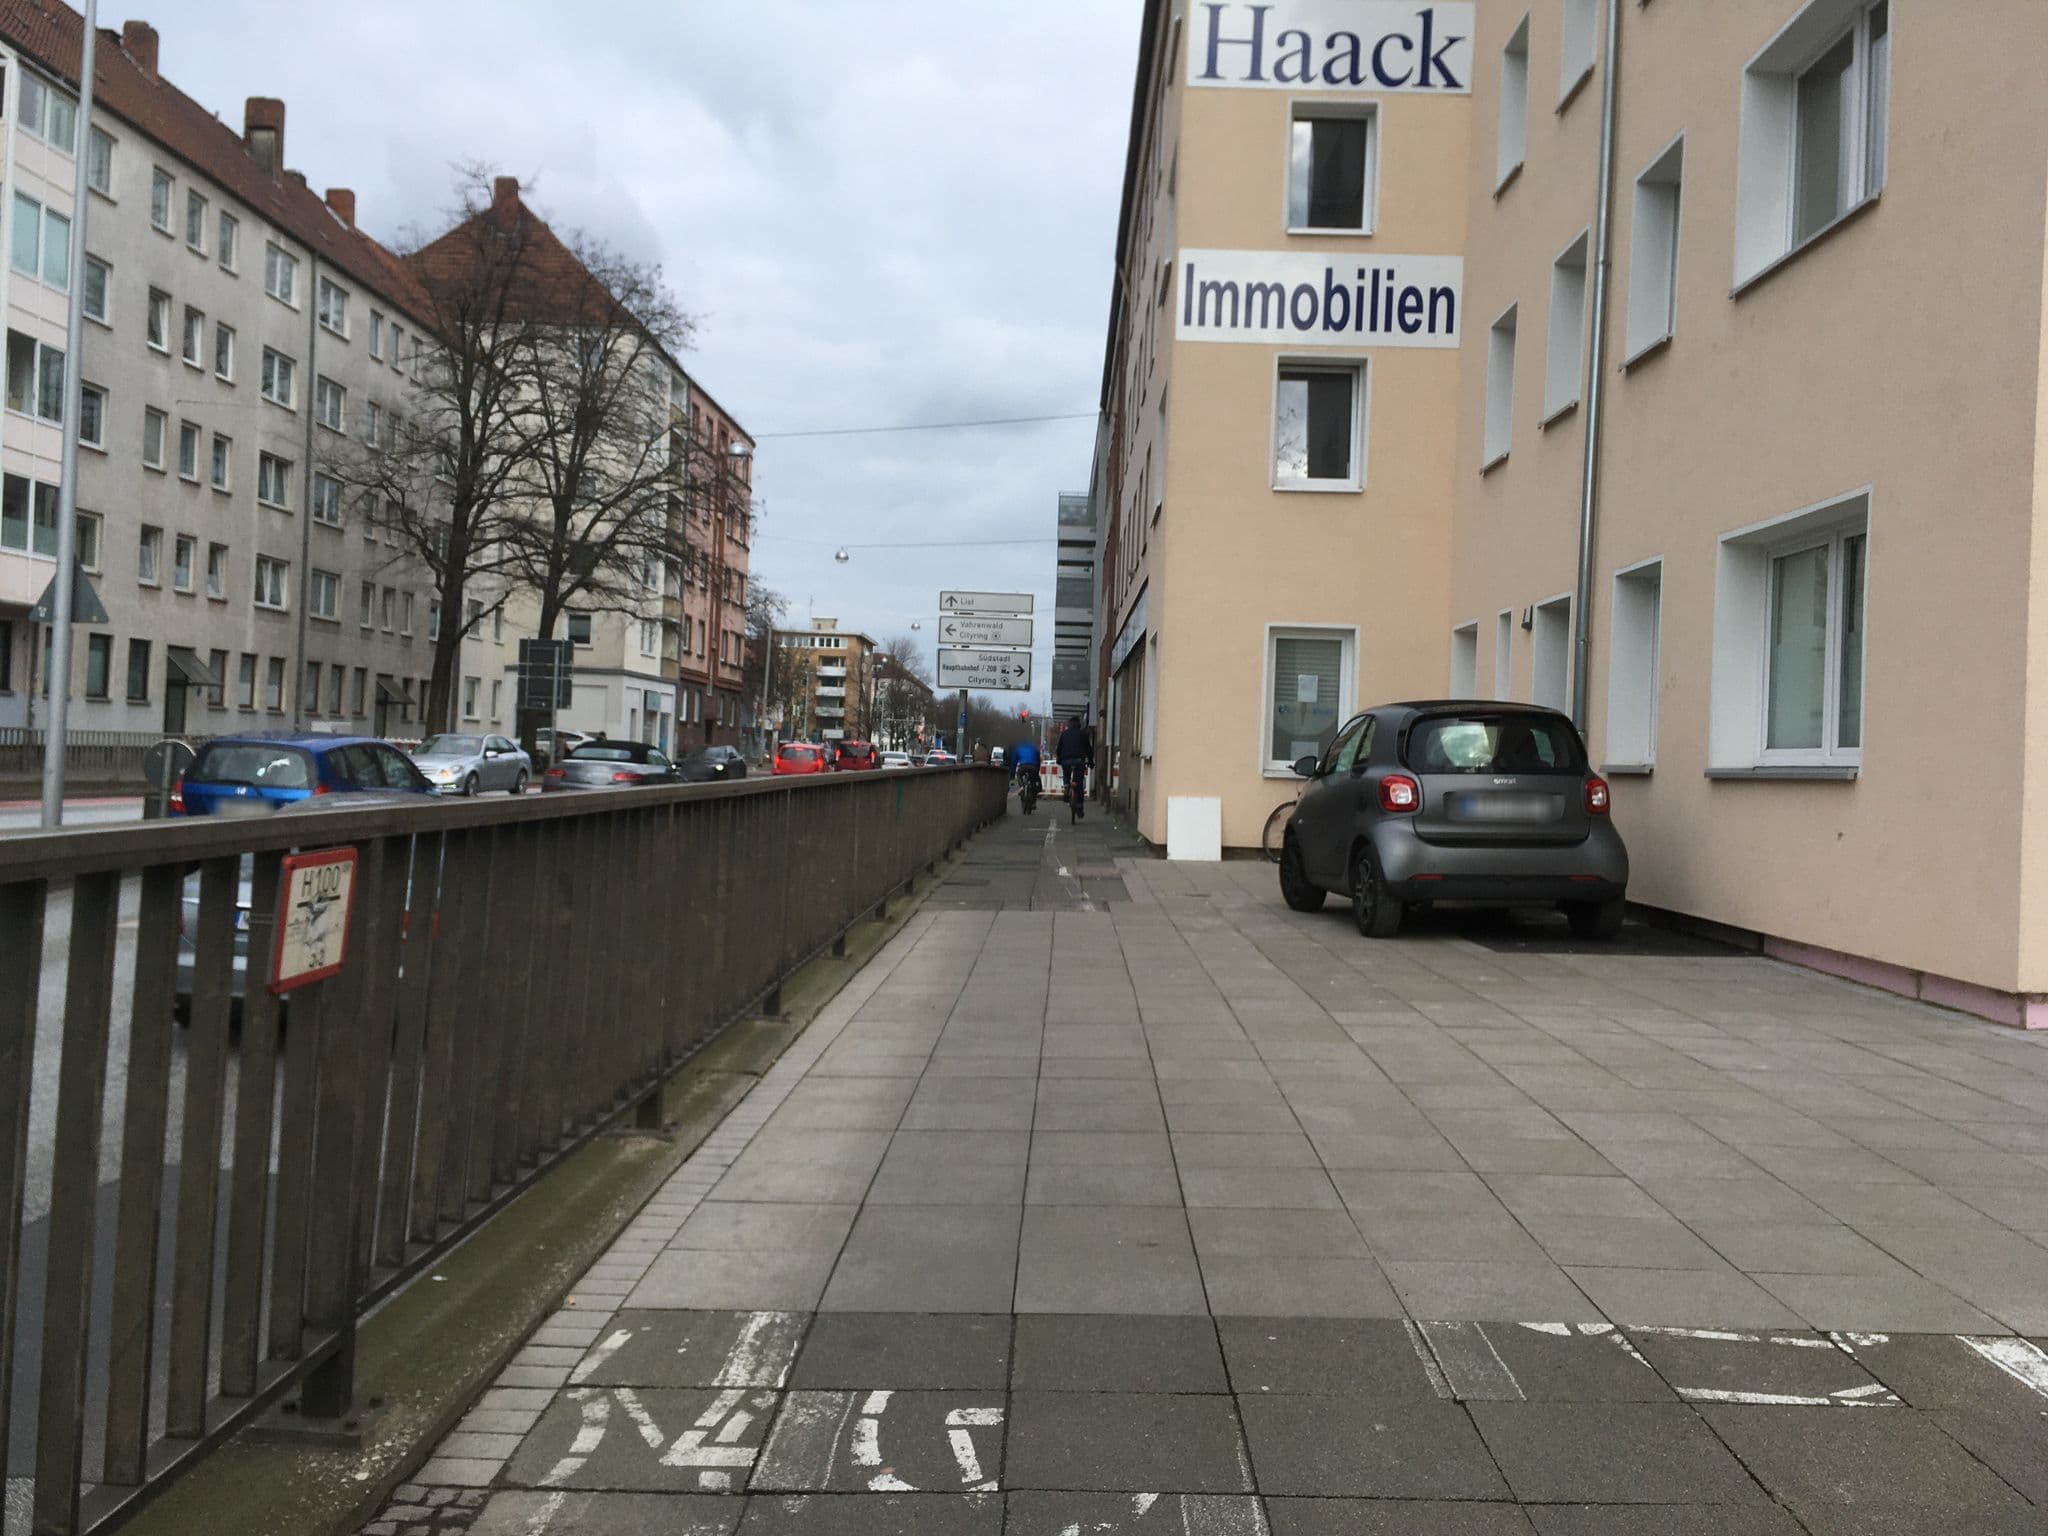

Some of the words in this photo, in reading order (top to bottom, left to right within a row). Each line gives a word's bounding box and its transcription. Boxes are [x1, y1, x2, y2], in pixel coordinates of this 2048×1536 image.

[1196, 3, 1466, 89] Haack
[1183, 262, 1455, 335] Immobilien
[960, 597, 974, 606] List
[960, 621, 1003, 630] Vahrenwald
[959, 631, 988, 641] Cityring
[978, 653, 1011, 662] Südstadt
[942, 663, 980, 672] Hauptbahnhof
[967, 675, 997, 686] Cityring
